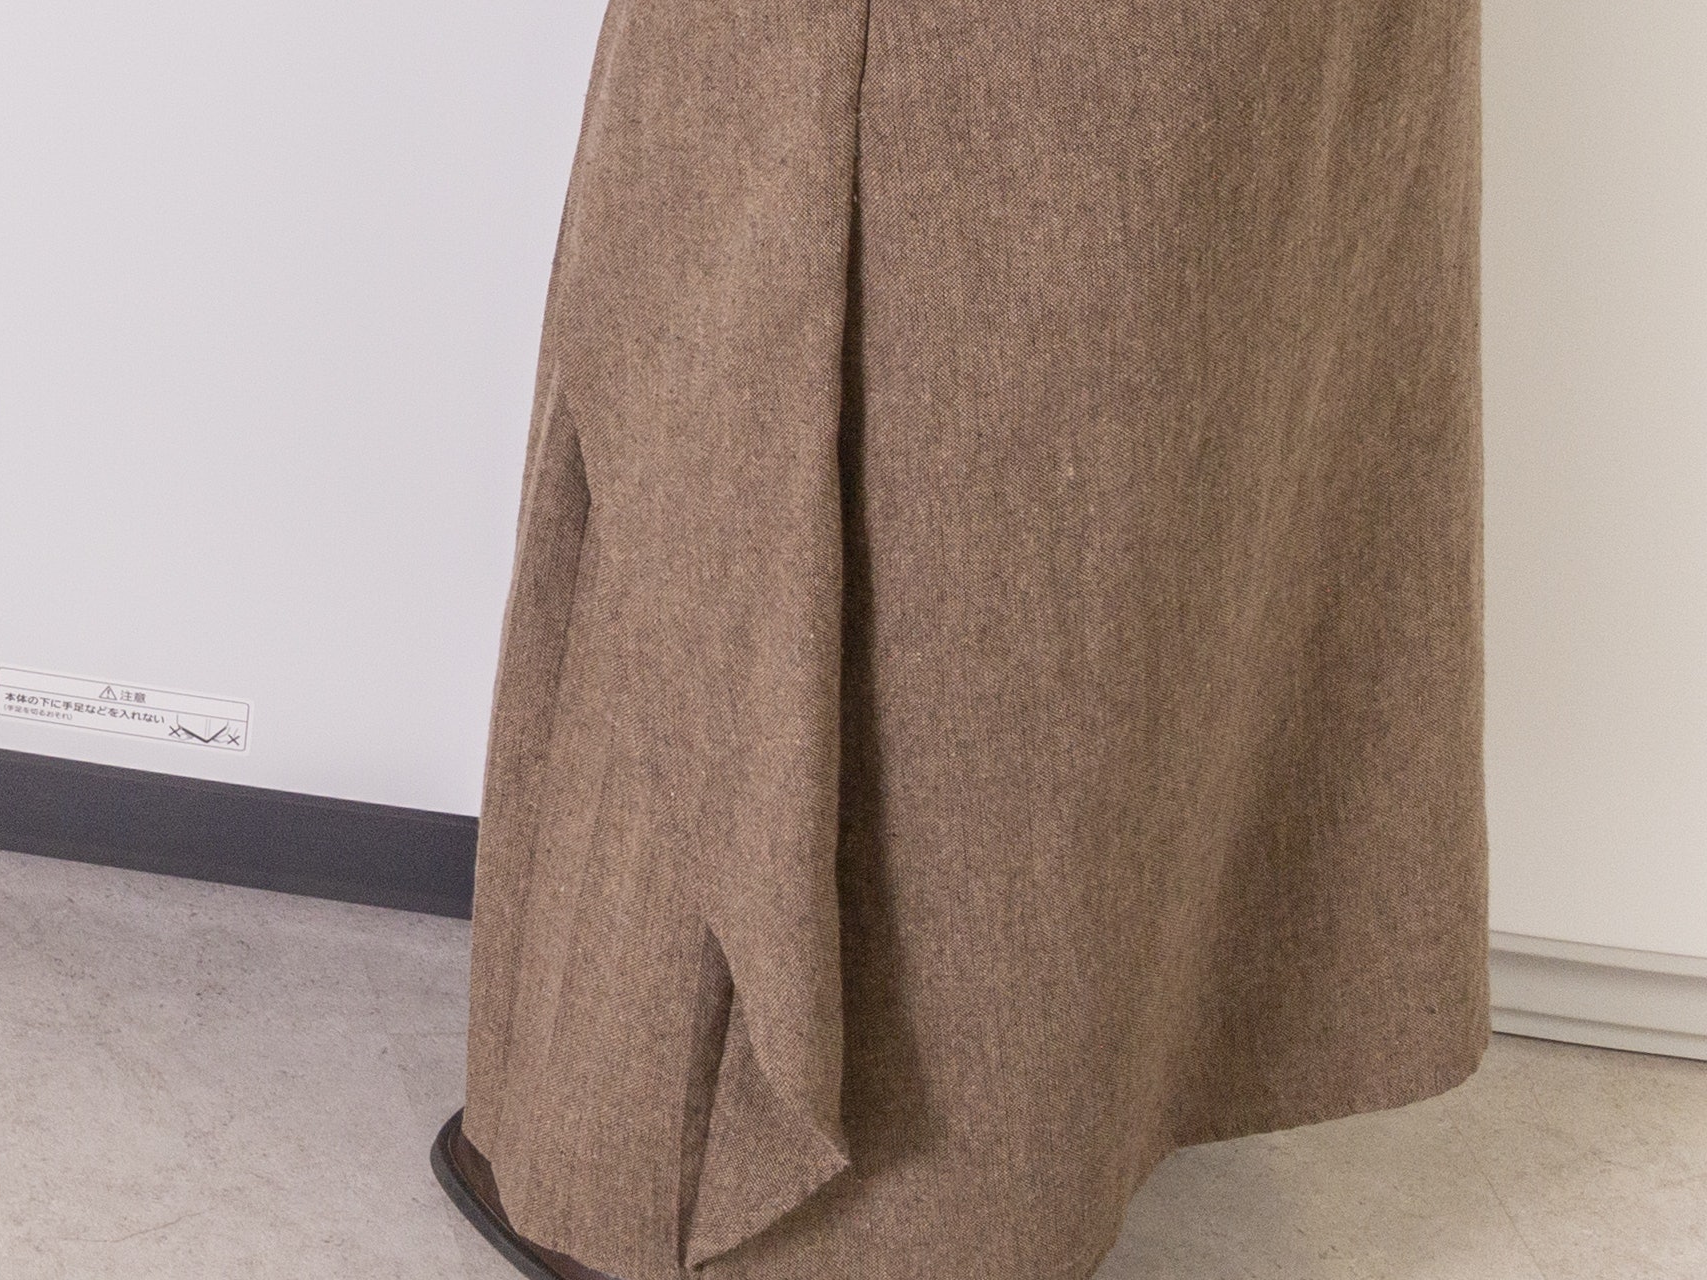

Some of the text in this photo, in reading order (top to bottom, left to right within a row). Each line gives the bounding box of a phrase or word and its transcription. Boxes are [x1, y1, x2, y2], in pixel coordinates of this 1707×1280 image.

[119, 690, 147, 703] 注意
[5, 692, 165, 725] 本体の下に手足などを入れない
